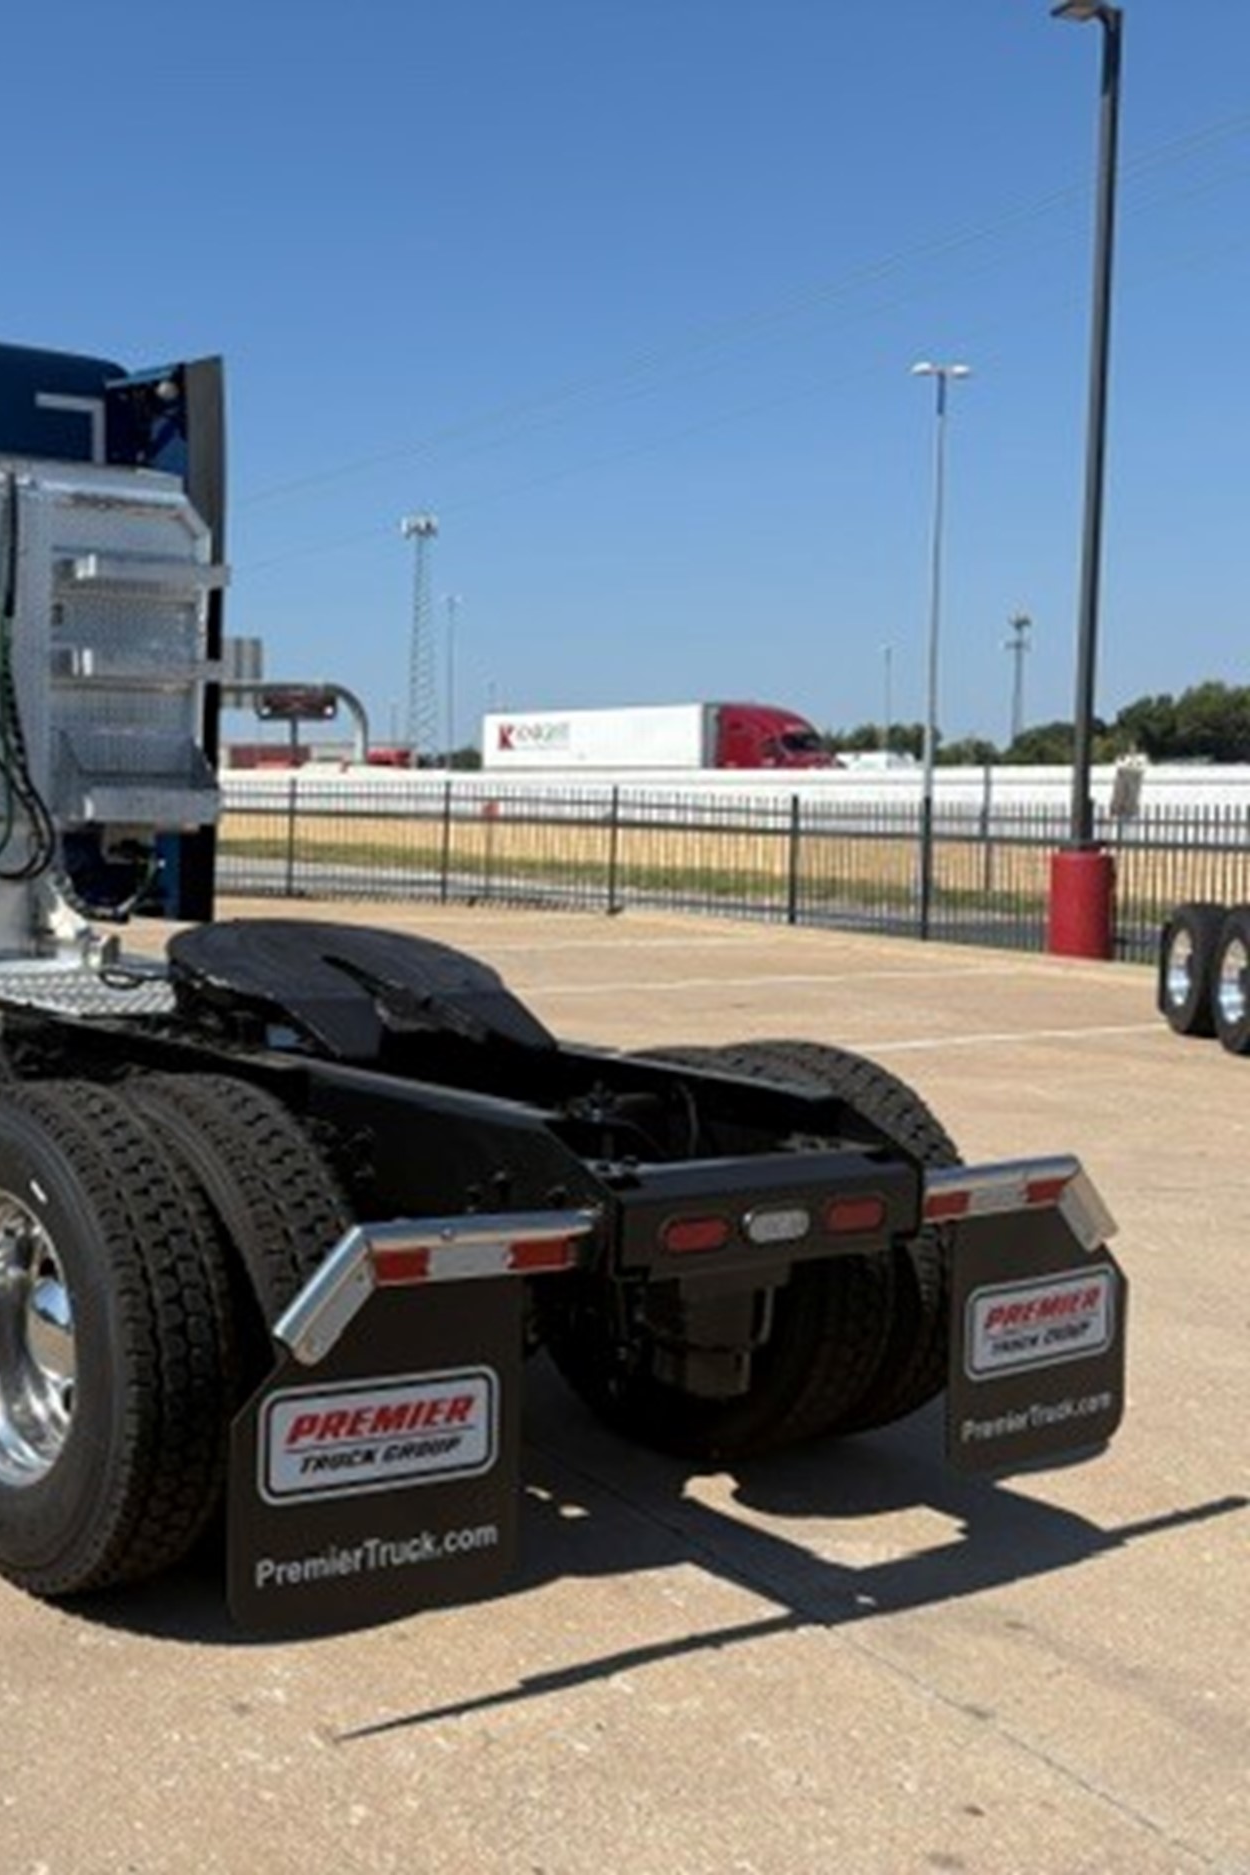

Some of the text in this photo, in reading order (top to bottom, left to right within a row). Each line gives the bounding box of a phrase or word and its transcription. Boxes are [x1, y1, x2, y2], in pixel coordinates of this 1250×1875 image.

[985, 1287, 1100, 1330] PREMIER
[285, 1397, 474, 1446] PREMIER
[961, 1393, 1111, 1442] PremierTruck.com
[299, 1438, 462, 1474] TRUCK GROUP
[255, 1525, 498, 1588] PremierTruck.com
